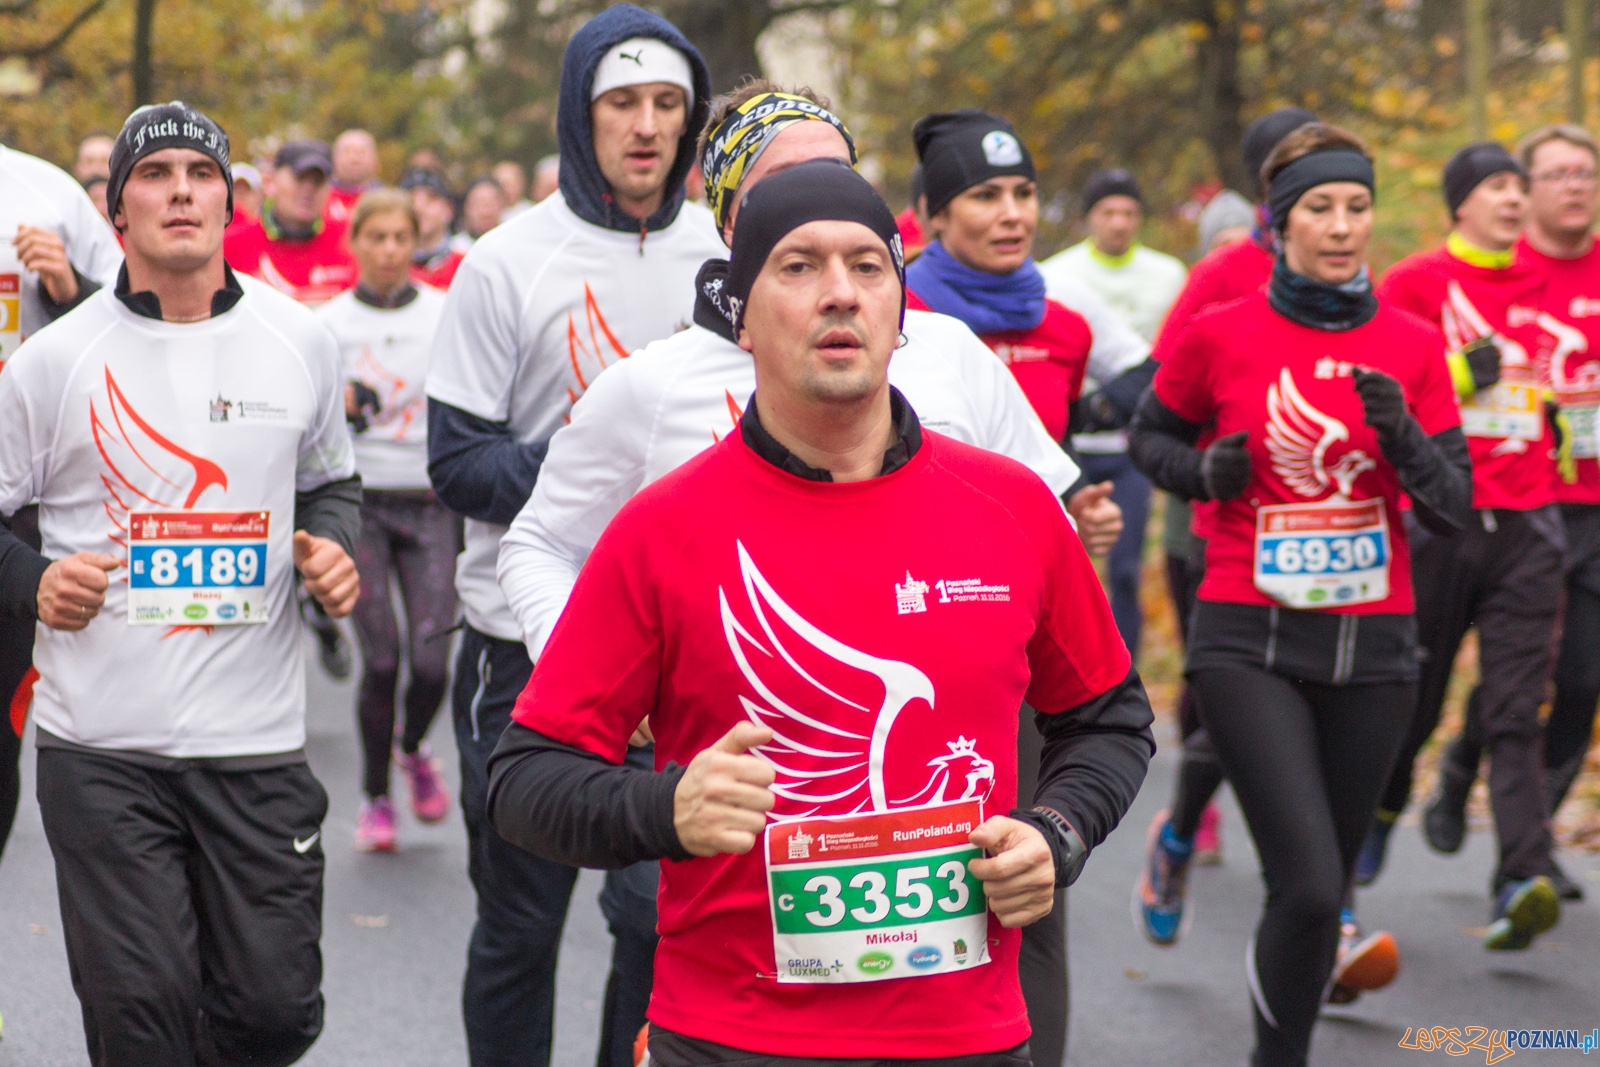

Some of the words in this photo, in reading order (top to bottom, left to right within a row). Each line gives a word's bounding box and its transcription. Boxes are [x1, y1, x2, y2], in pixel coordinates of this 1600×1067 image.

[133, 118, 178, 154] Fuck
[183, 121, 205, 140] the
[1275, 536, 1377, 574] 6930
[150, 547, 259, 586] 8189
[935, 579, 951, 603] 1
[817, 833, 828, 852] 1
[893, 821, 972, 842] RunPoland.org
[803, 860, 970, 927] 3353
[866, 930, 918, 945] Mikołaj
[787, 959, 823, 968] GRUPA
[789, 968, 830, 977] LUXMED
